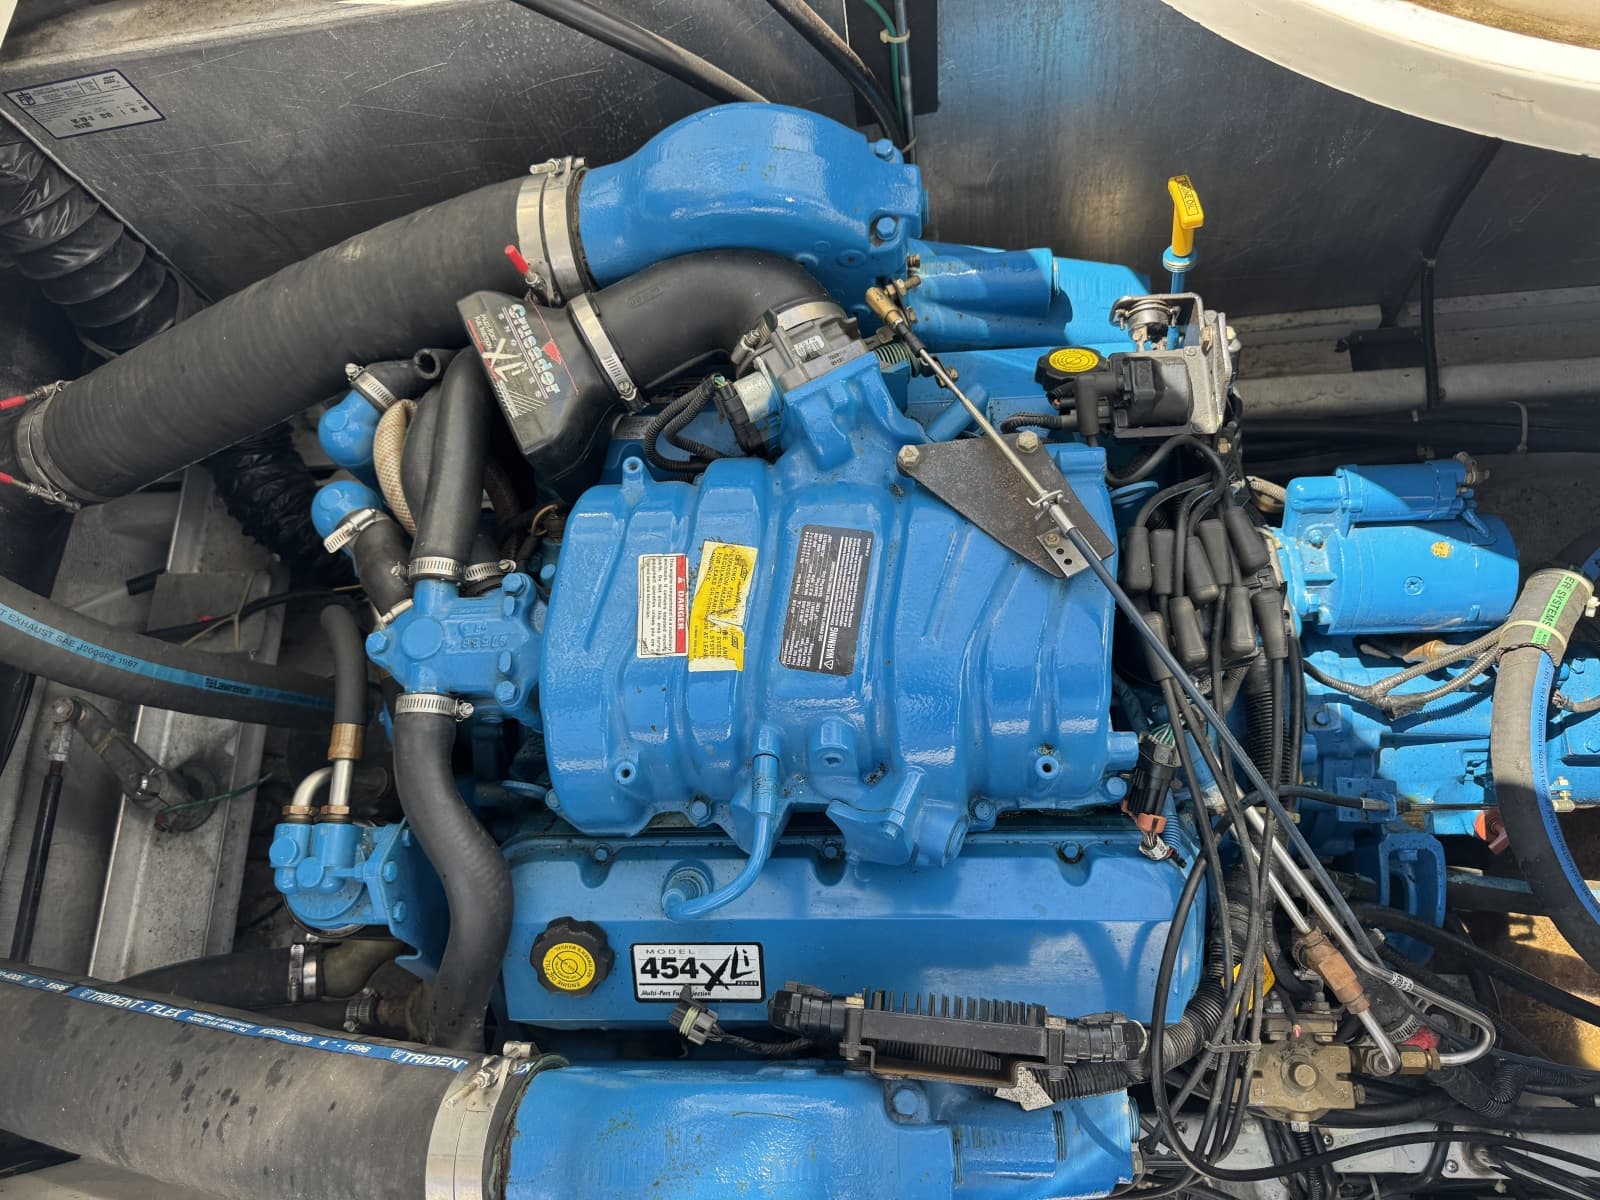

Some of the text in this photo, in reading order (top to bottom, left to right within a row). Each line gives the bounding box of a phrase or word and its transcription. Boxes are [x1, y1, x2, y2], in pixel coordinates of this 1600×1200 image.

[509, 304, 561, 394] Crusader
[1542, 590, 1567, 627] SYSTEMS
[8, 613, 55, 639] EXHAUST
[55, 633, 76, 649] SAE
[76, 639, 117, 663] J2006R2
[824, 626, 839, 659] WARNING
[640, 957, 699, 979] 454
[88, 991, 141, 1008] TRIDENT
[147, 1004, 187, 1019] FLEX
[344, 1043, 370, 1053] 1996
